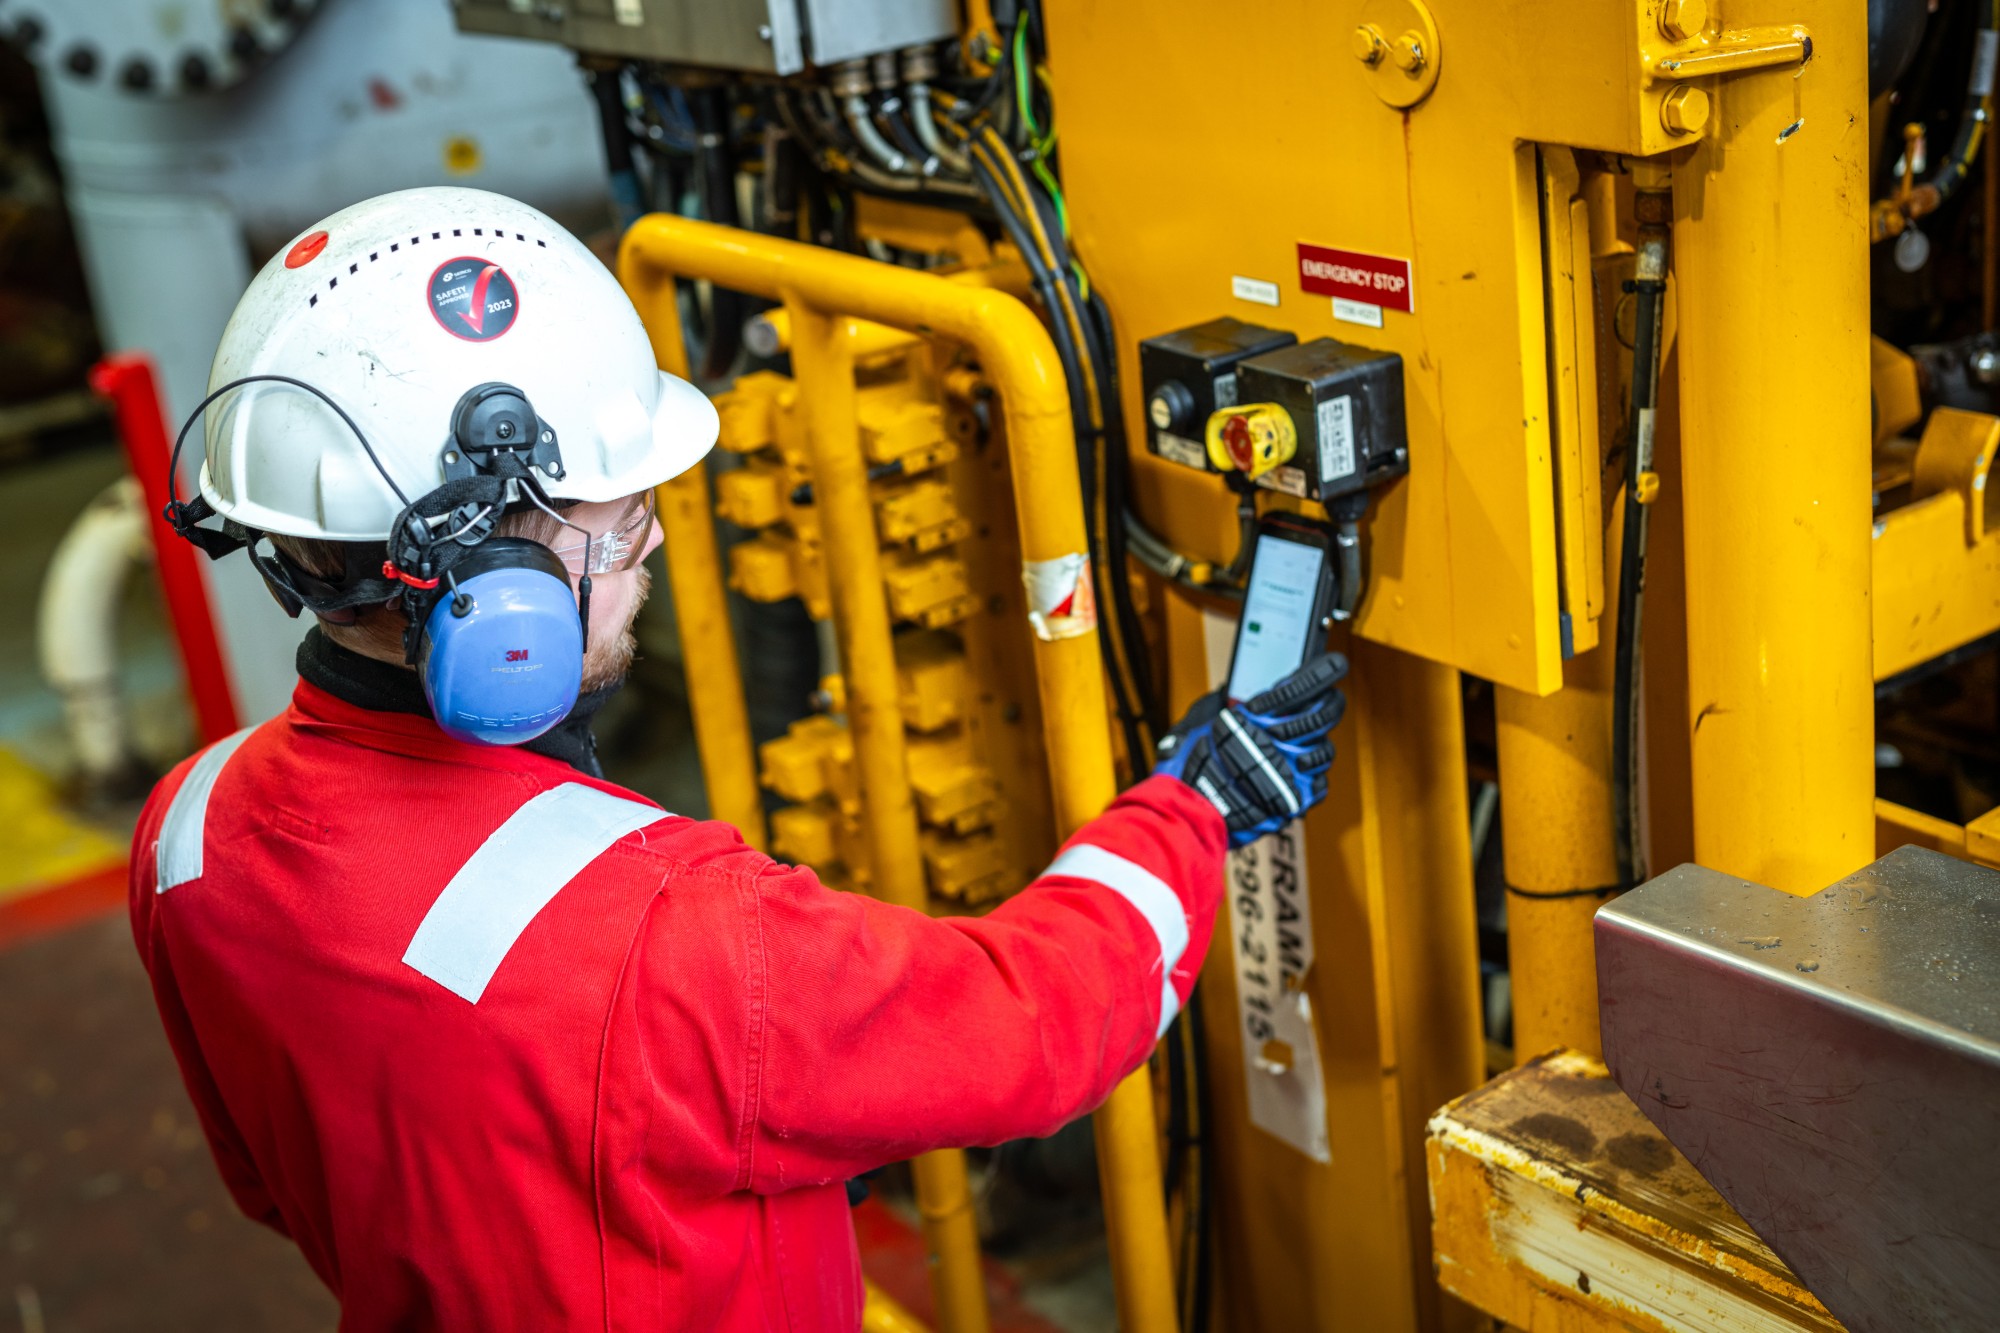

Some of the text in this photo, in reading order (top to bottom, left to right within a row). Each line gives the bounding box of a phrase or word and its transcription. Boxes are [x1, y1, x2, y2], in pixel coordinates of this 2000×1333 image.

[1301, 258, 1406, 293] EMERGENCY STOP
[436, 285, 466, 301] SAFETY
[438, 292, 470, 307] APPROVED
[487, 298, 512, 314] 2023
[505, 649, 528, 662] 3M
